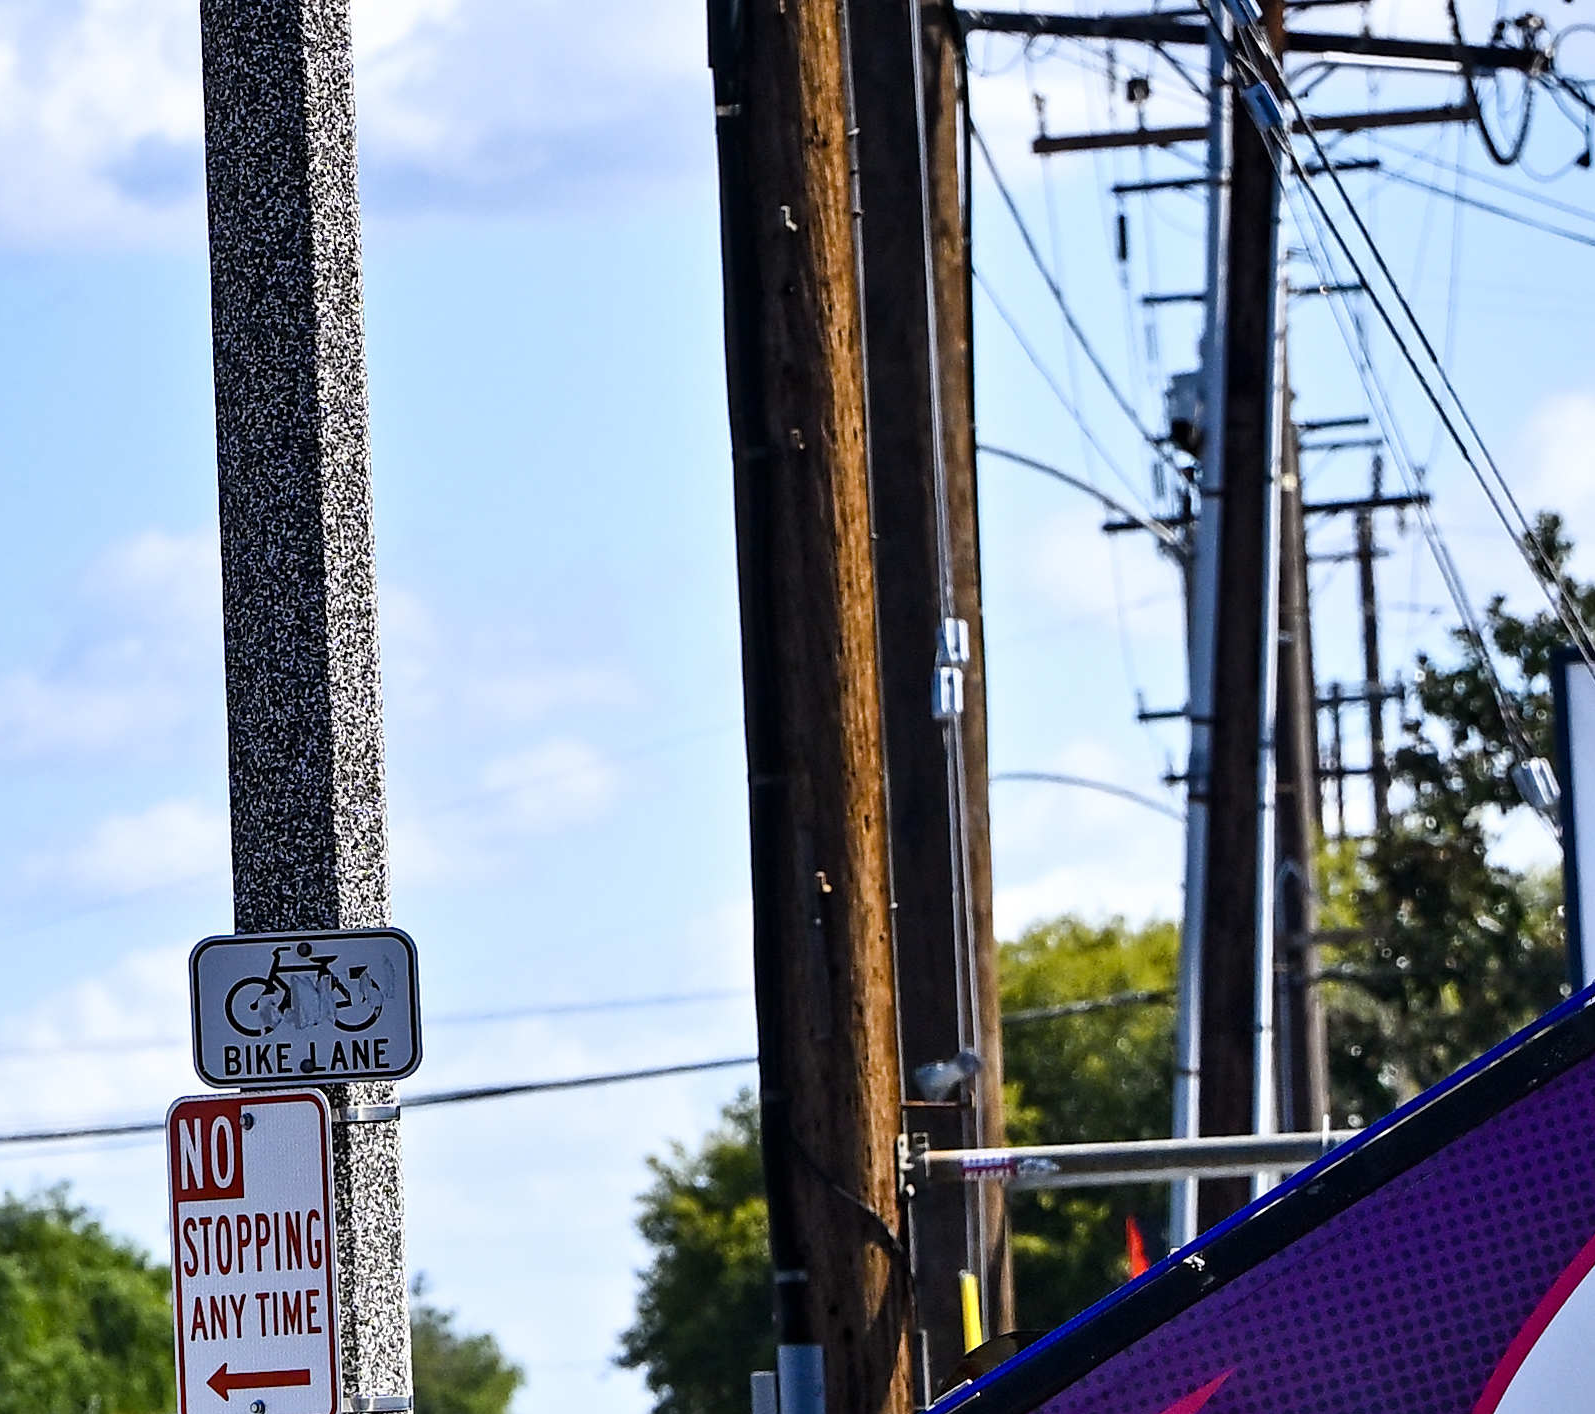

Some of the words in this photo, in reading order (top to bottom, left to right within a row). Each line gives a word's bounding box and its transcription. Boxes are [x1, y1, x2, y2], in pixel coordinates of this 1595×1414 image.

[224, 1042, 293, 1076] BIKE
[306, 1038, 391, 1074] LANE
[180, 1114, 238, 1192] NO
[182, 1210, 324, 1278] STOPPING
[191, 1293, 244, 1342] ANY
[255, 1289, 323, 1336] TIME
